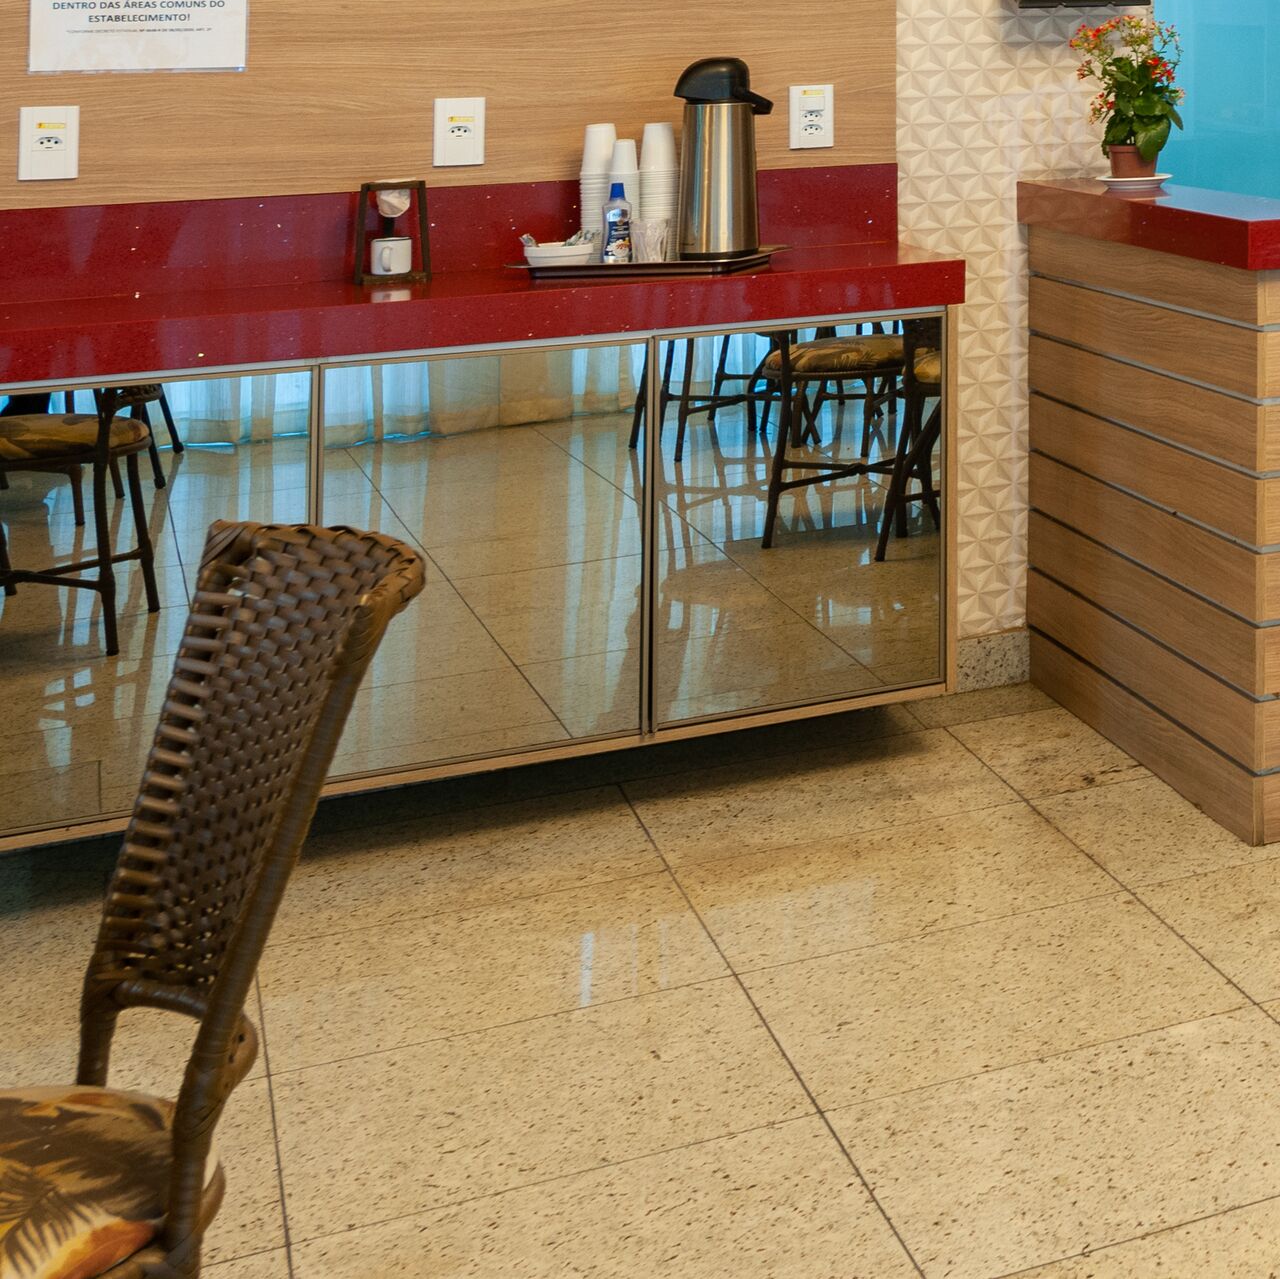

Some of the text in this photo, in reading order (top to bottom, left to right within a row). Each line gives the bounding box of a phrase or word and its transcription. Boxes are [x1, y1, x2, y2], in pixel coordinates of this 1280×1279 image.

[53, 0, 225, 9] DENTRO DAS ÁREAS COMUNS DO
[88, 13, 190, 23] ESTABELECIMENTO!
